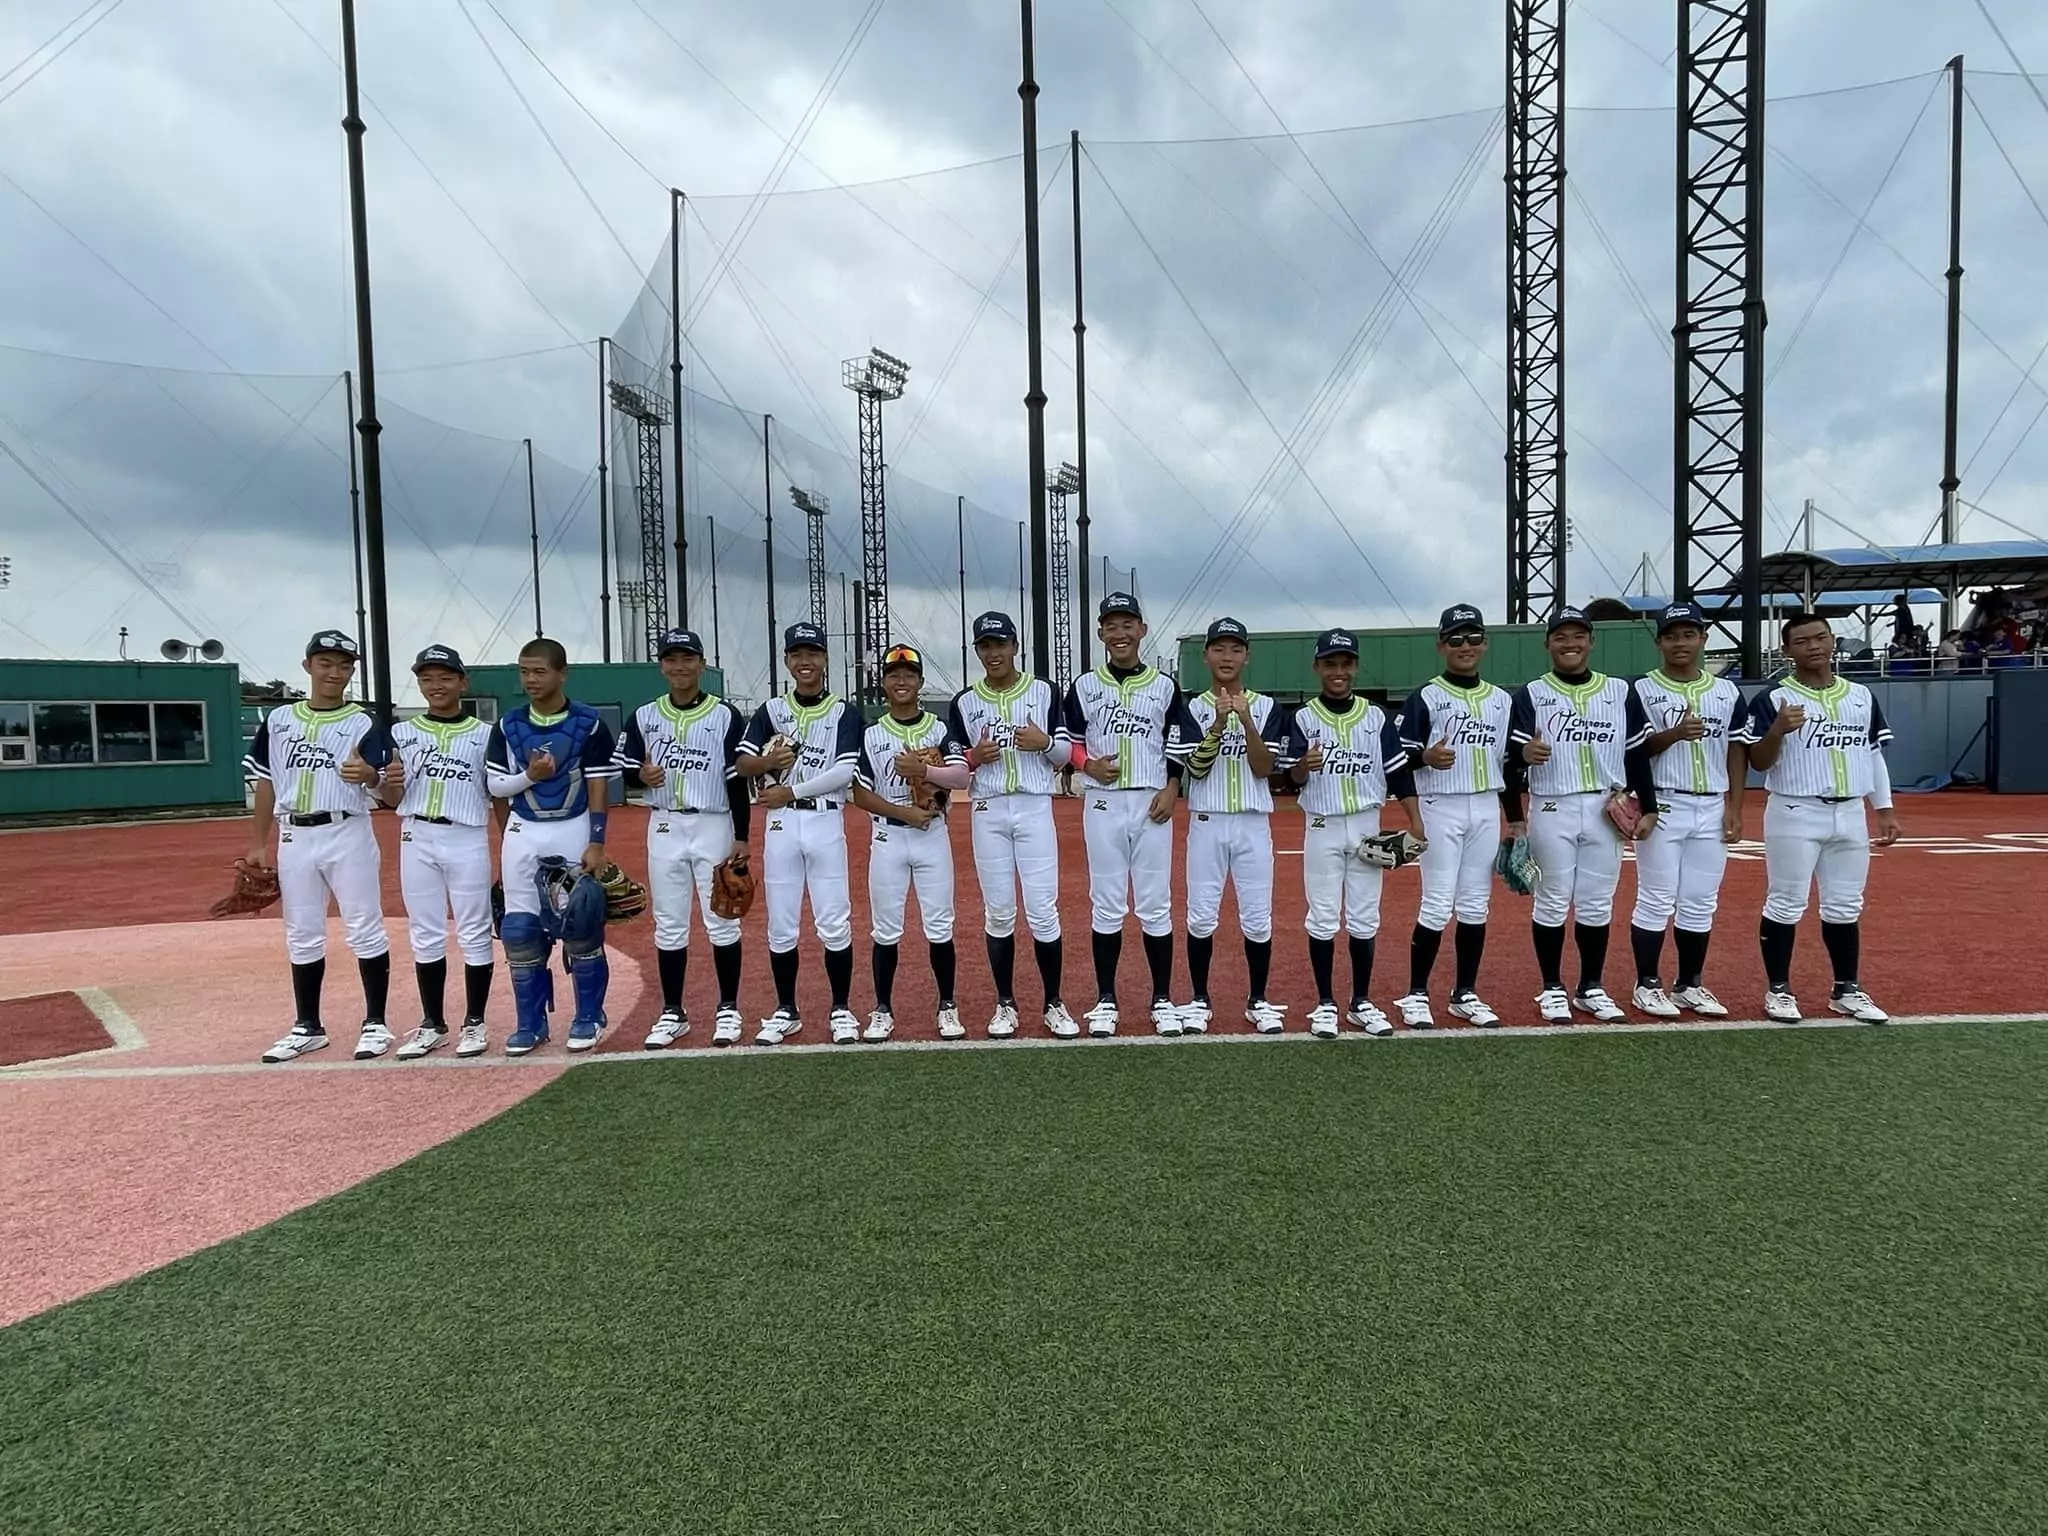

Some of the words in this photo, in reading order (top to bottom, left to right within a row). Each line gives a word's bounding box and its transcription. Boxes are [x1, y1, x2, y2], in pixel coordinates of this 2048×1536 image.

[1110, 718, 1153, 739] Taipei
[1572, 718, 1612, 729] Chinese
[1822, 723, 1865, 733] Chinese
[1221, 732, 1245, 742] Chin
[1564, 728, 1616, 745] Taipei
[1814, 733, 1868, 750] Taipei
[670, 744, 708, 758] Chinese
[290, 753, 336, 771] Taipe
[664, 755, 711, 773] Taipei
[1328, 759, 1373, 777] Taipe
